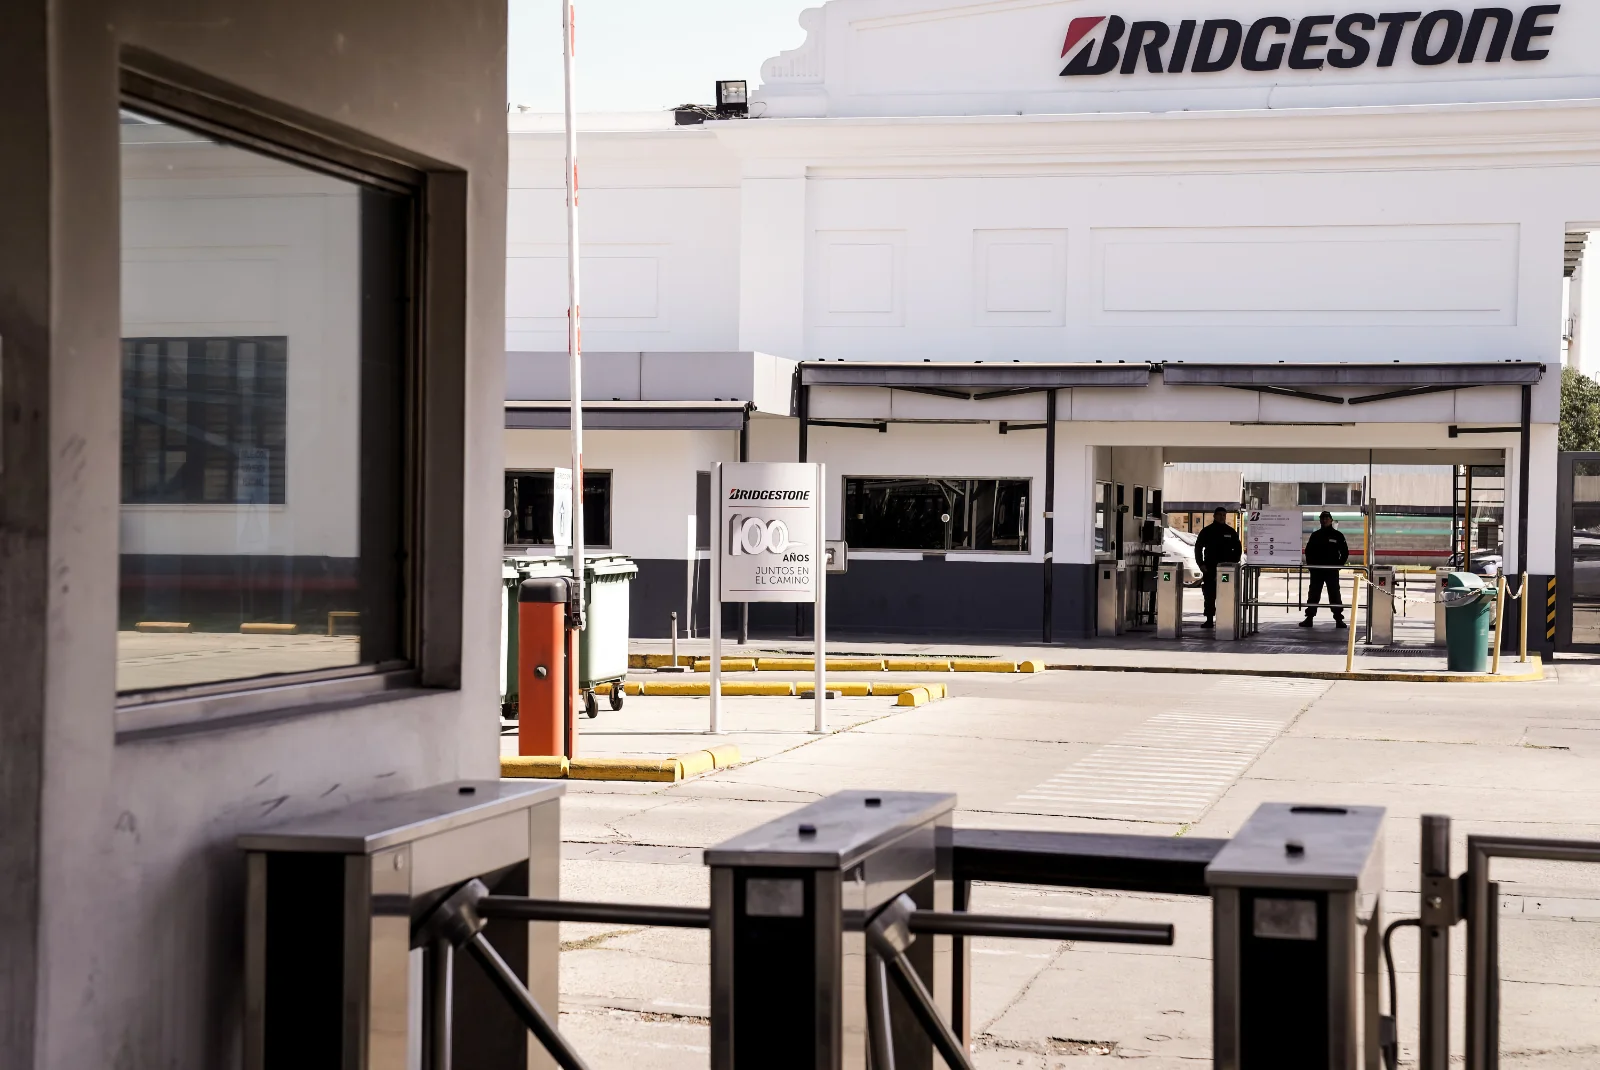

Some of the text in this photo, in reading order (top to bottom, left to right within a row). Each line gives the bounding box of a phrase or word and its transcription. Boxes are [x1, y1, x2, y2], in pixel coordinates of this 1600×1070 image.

[1059, 4, 1561, 77] BRIDGESTONE
[728, 488, 810, 501] BRIDGESTONE
[728, 513, 789, 556] 100
[782, 553, 810, 562] AÑOS
[755, 566, 809, 575] JUNTOS EN
[755, 575, 810, 585] EL CAMINO
